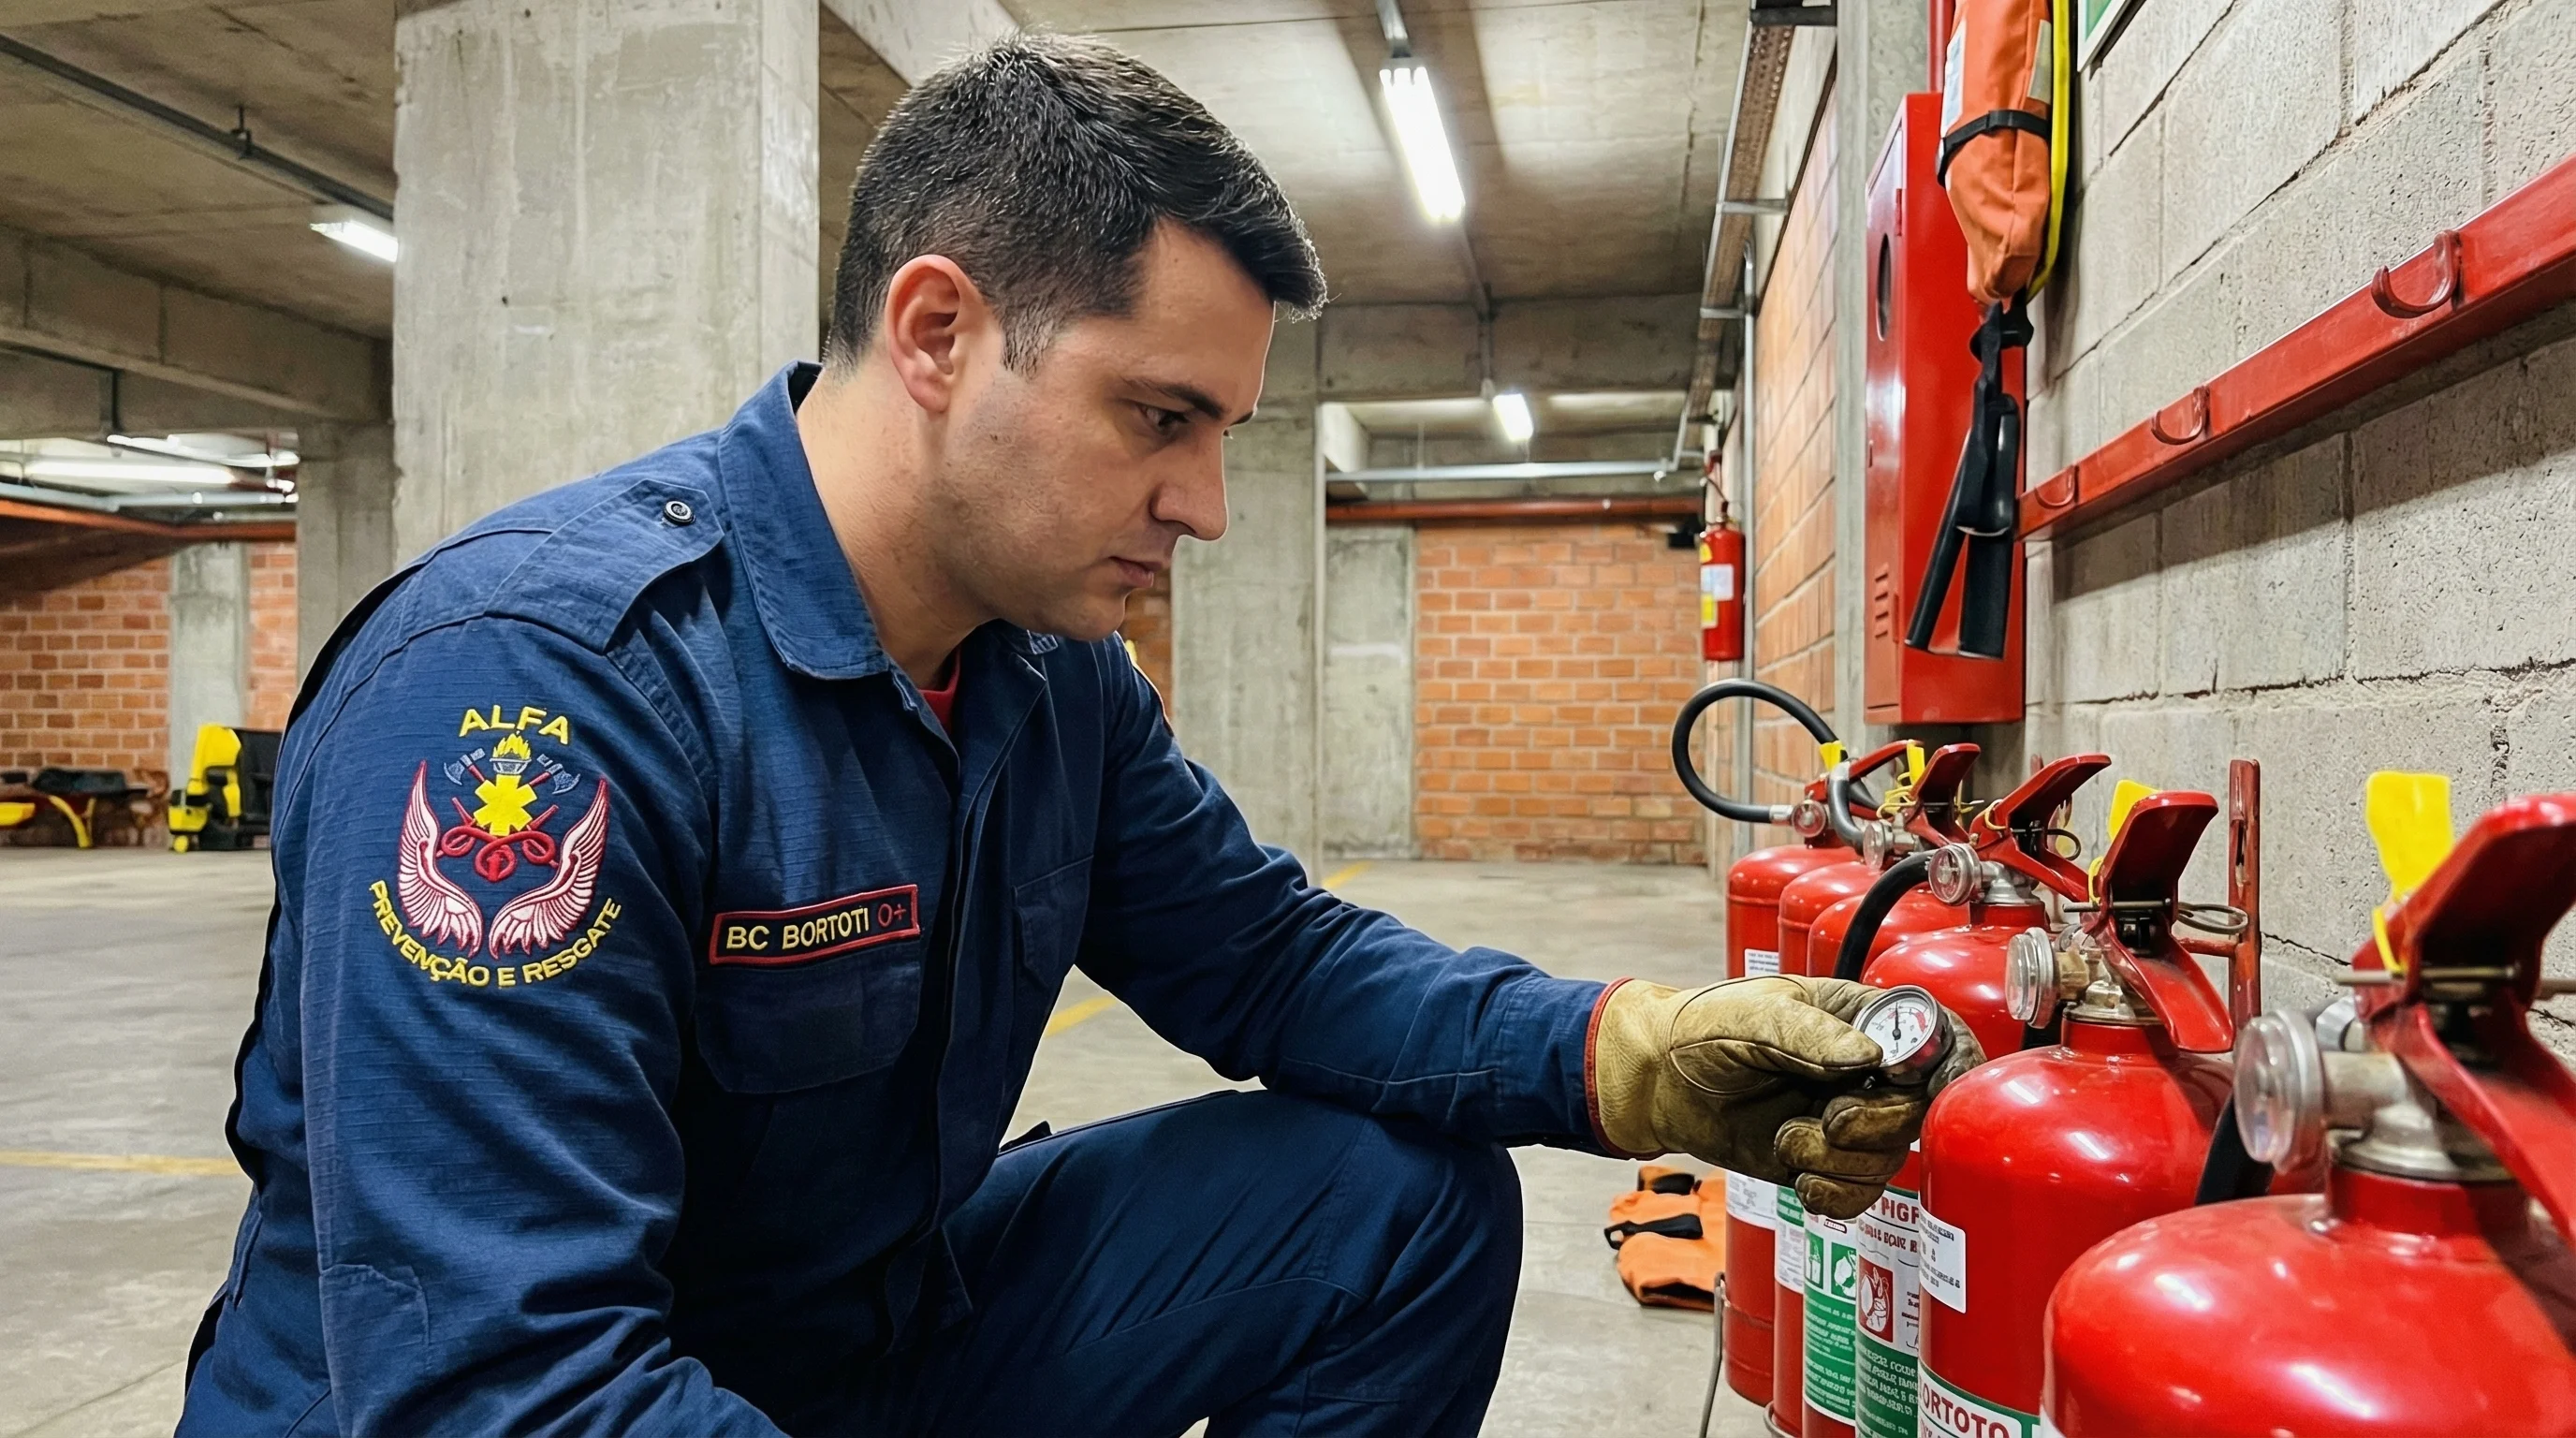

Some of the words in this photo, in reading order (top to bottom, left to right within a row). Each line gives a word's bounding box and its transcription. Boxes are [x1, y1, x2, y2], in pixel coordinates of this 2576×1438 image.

[459, 705, 569, 744] ALFA
[369, 879, 490, 987] PREVENÇÃO
[497, 967, 516, 987] E
[522, 898, 622, 983] RESGATE
[726, 925, 769, 950] BC
[782, 907, 869, 949] BORTOTI
